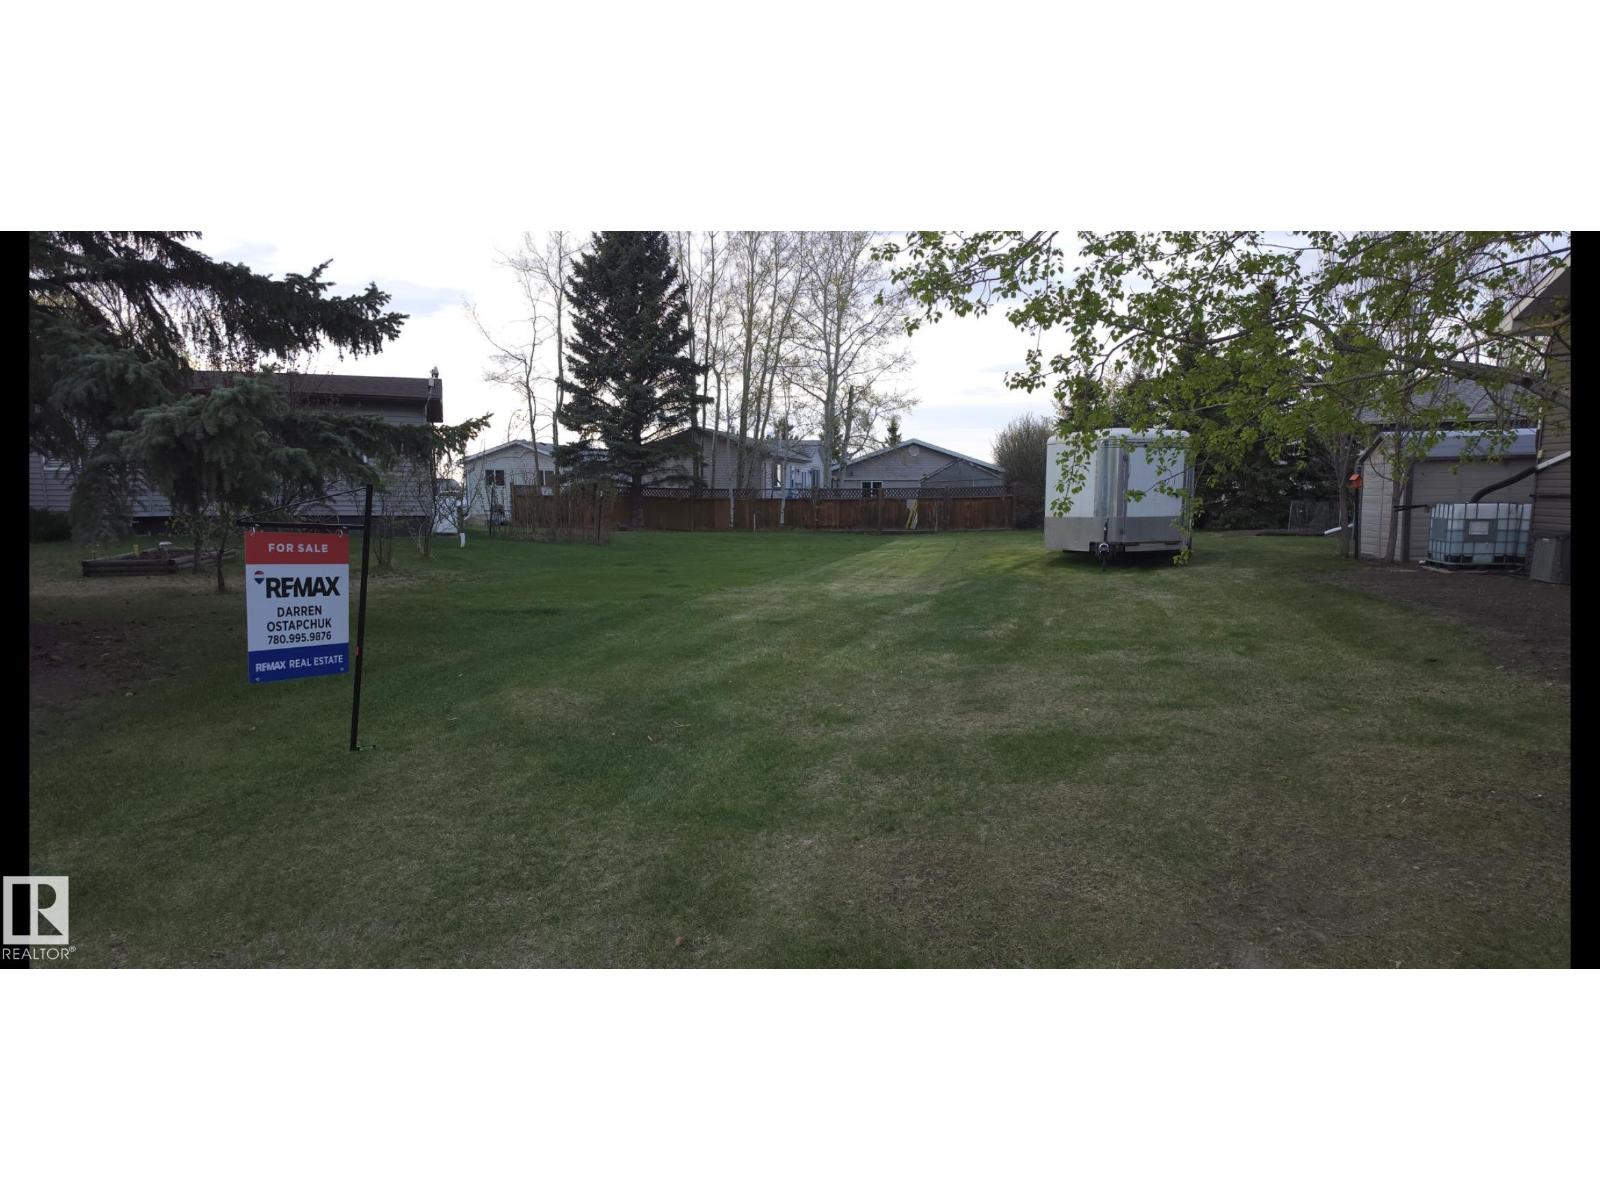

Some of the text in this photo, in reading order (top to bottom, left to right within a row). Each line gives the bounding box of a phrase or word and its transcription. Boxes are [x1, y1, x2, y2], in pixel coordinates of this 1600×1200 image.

[268, 543, 329, 553] FOR SALE
[277, 605, 322, 618] DARREN
[266, 618, 332, 632] OSTAPCHUK
[268, 631, 332, 644] 780.995.9876
[289, 658, 312, 670] REAL
[314, 655, 343, 666] ESTATE
